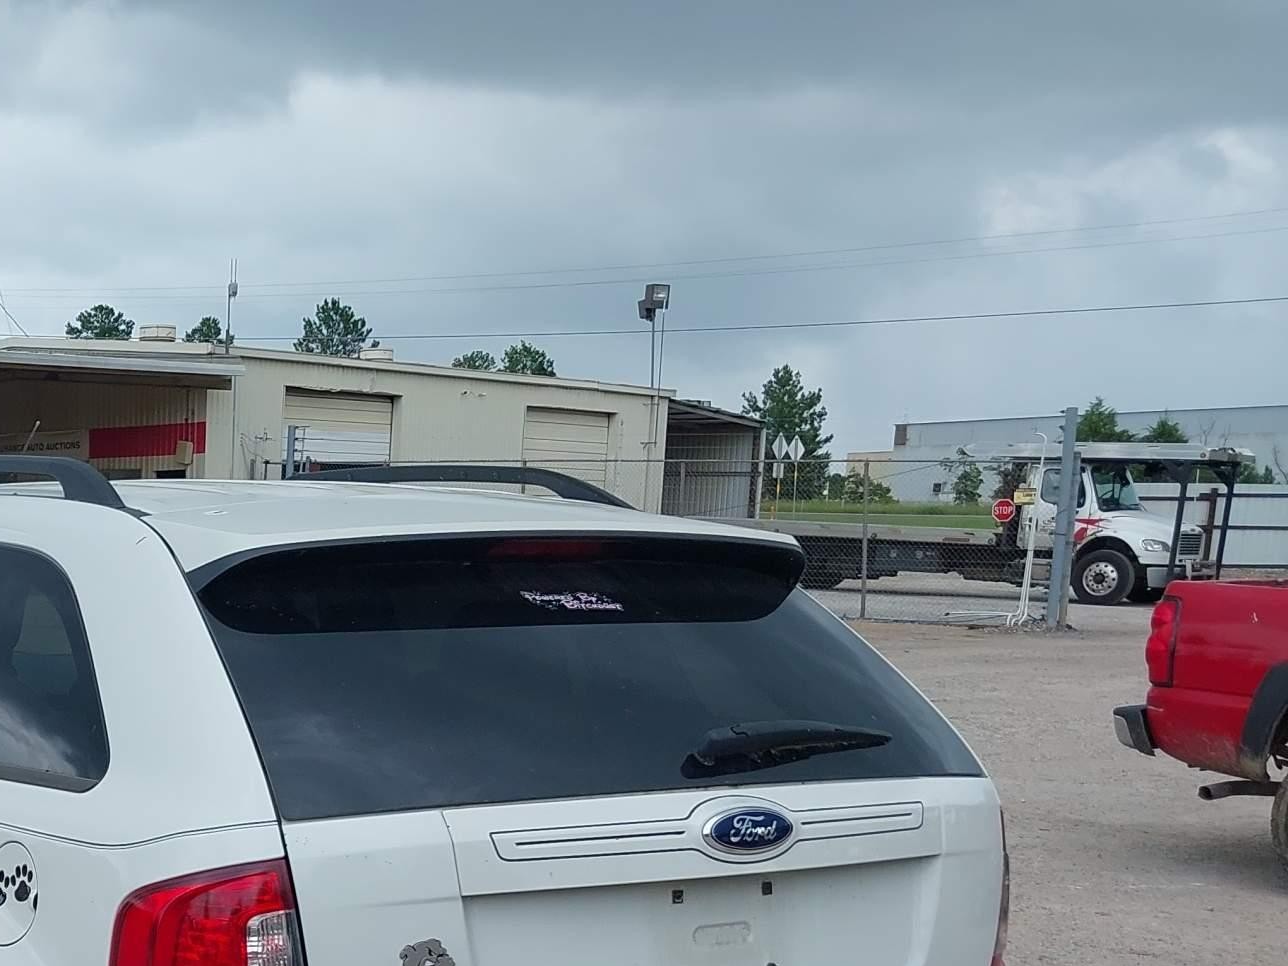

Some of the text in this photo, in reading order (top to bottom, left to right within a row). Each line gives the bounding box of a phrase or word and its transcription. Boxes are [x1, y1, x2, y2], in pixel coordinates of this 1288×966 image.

[27, 441, 45, 452] AUTO
[45, 440, 81, 451] AUCTIONS
[995, 506, 1013, 515] STOP
[729, 815, 777, 843] Ford
